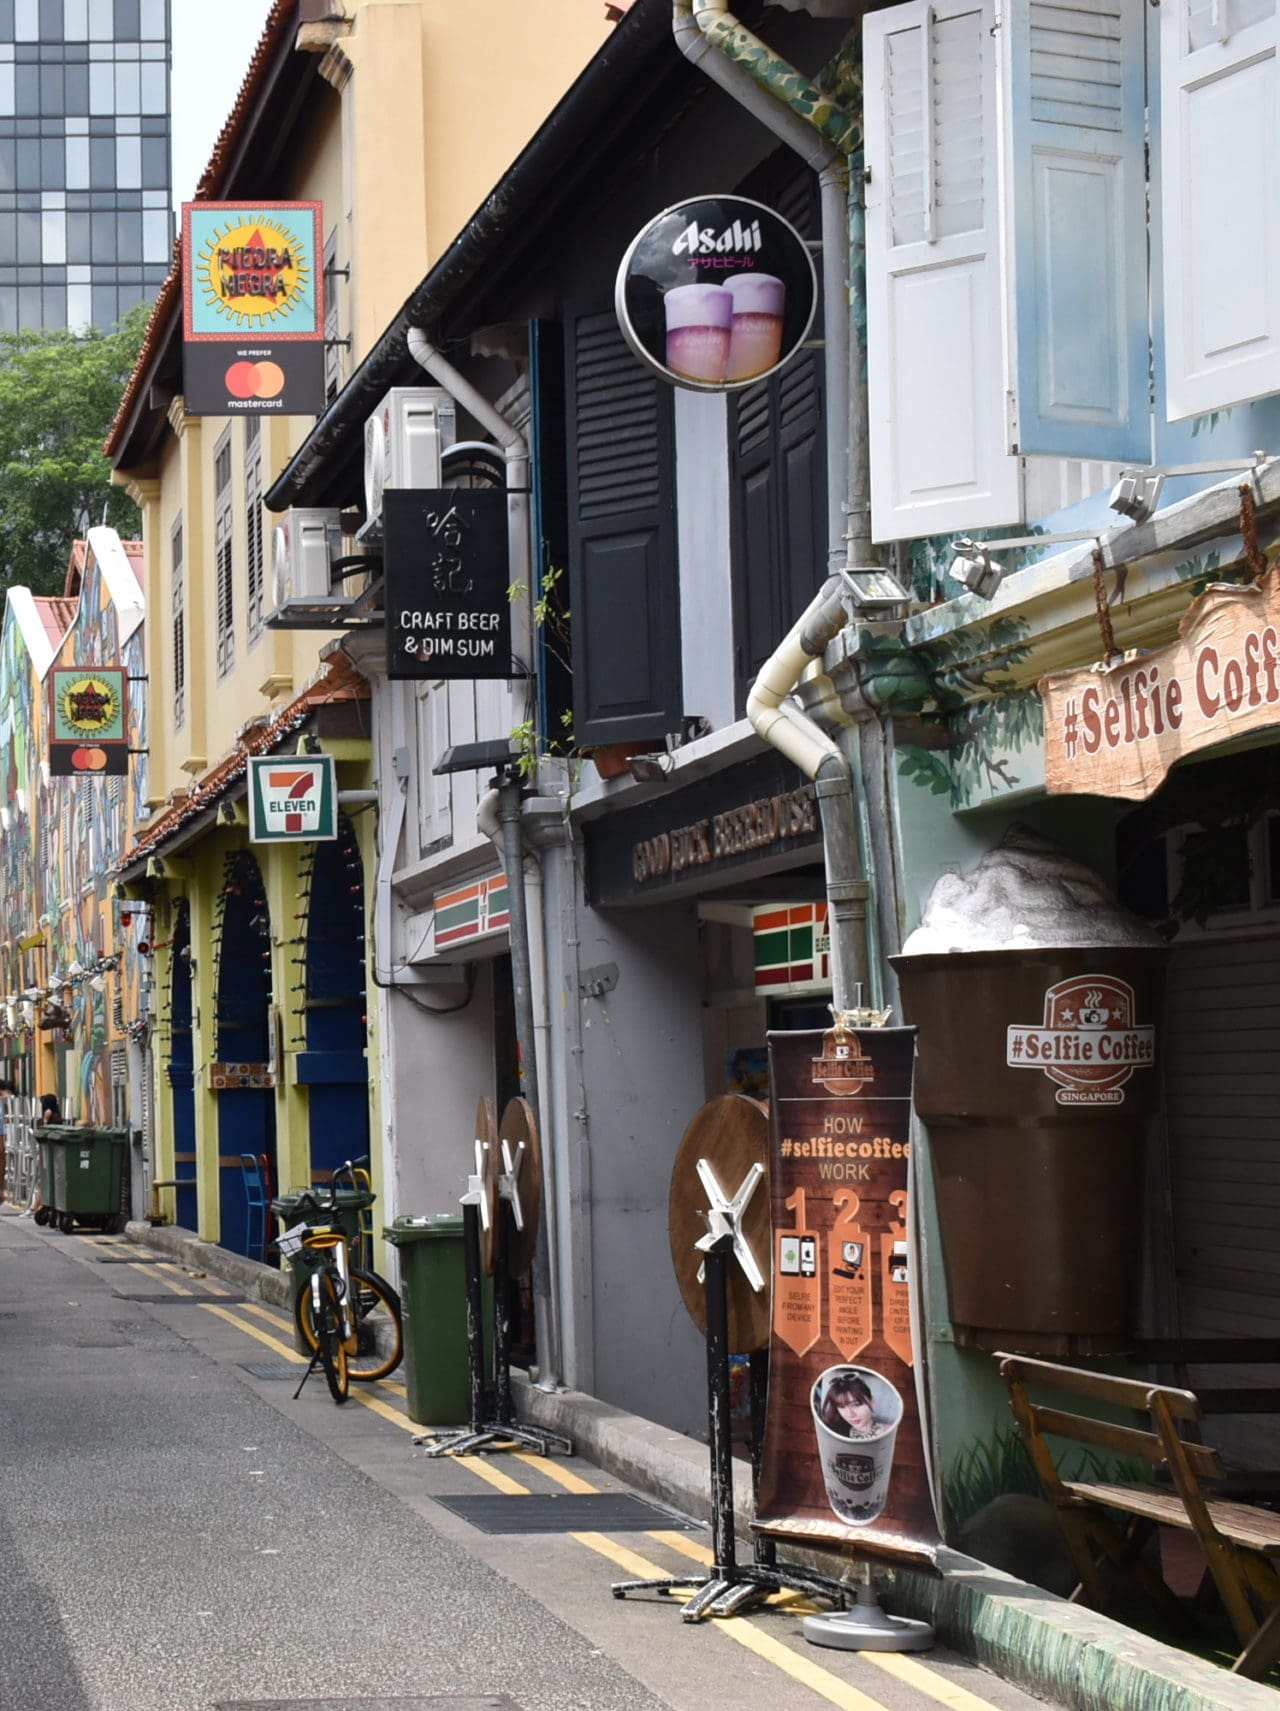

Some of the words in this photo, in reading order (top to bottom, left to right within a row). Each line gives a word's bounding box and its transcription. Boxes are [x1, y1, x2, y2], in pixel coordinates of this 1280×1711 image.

[672, 219, 762, 256] Asahi
[217, 247, 294, 270] PIEDRA
[687, 256, 754, 270] アサヒビール
[220, 273, 288, 297] NEGRA
[227, 399, 283, 408] mastercard
[401, 610, 453, 629] CRAFT
[458, 612, 500, 631] BEER
[404, 636, 418, 654] &
[423, 638, 454, 656] DIM
[456, 639, 494, 657] SUM
[1064, 665, 1183, 760] #Selfie
[269, 770, 314, 832] 7
[1012, 1034, 1093, 1061] #Selfie
[1098, 1034, 1152, 1061] Coffee
[1061, 1092, 1120, 1101] SINGAPORE
[824, 1117, 863, 1134] HOW
[819, 1164, 870, 1181] WORK
[785, 1187, 806, 1231] 1
[833, 1188, 860, 1233] 2
